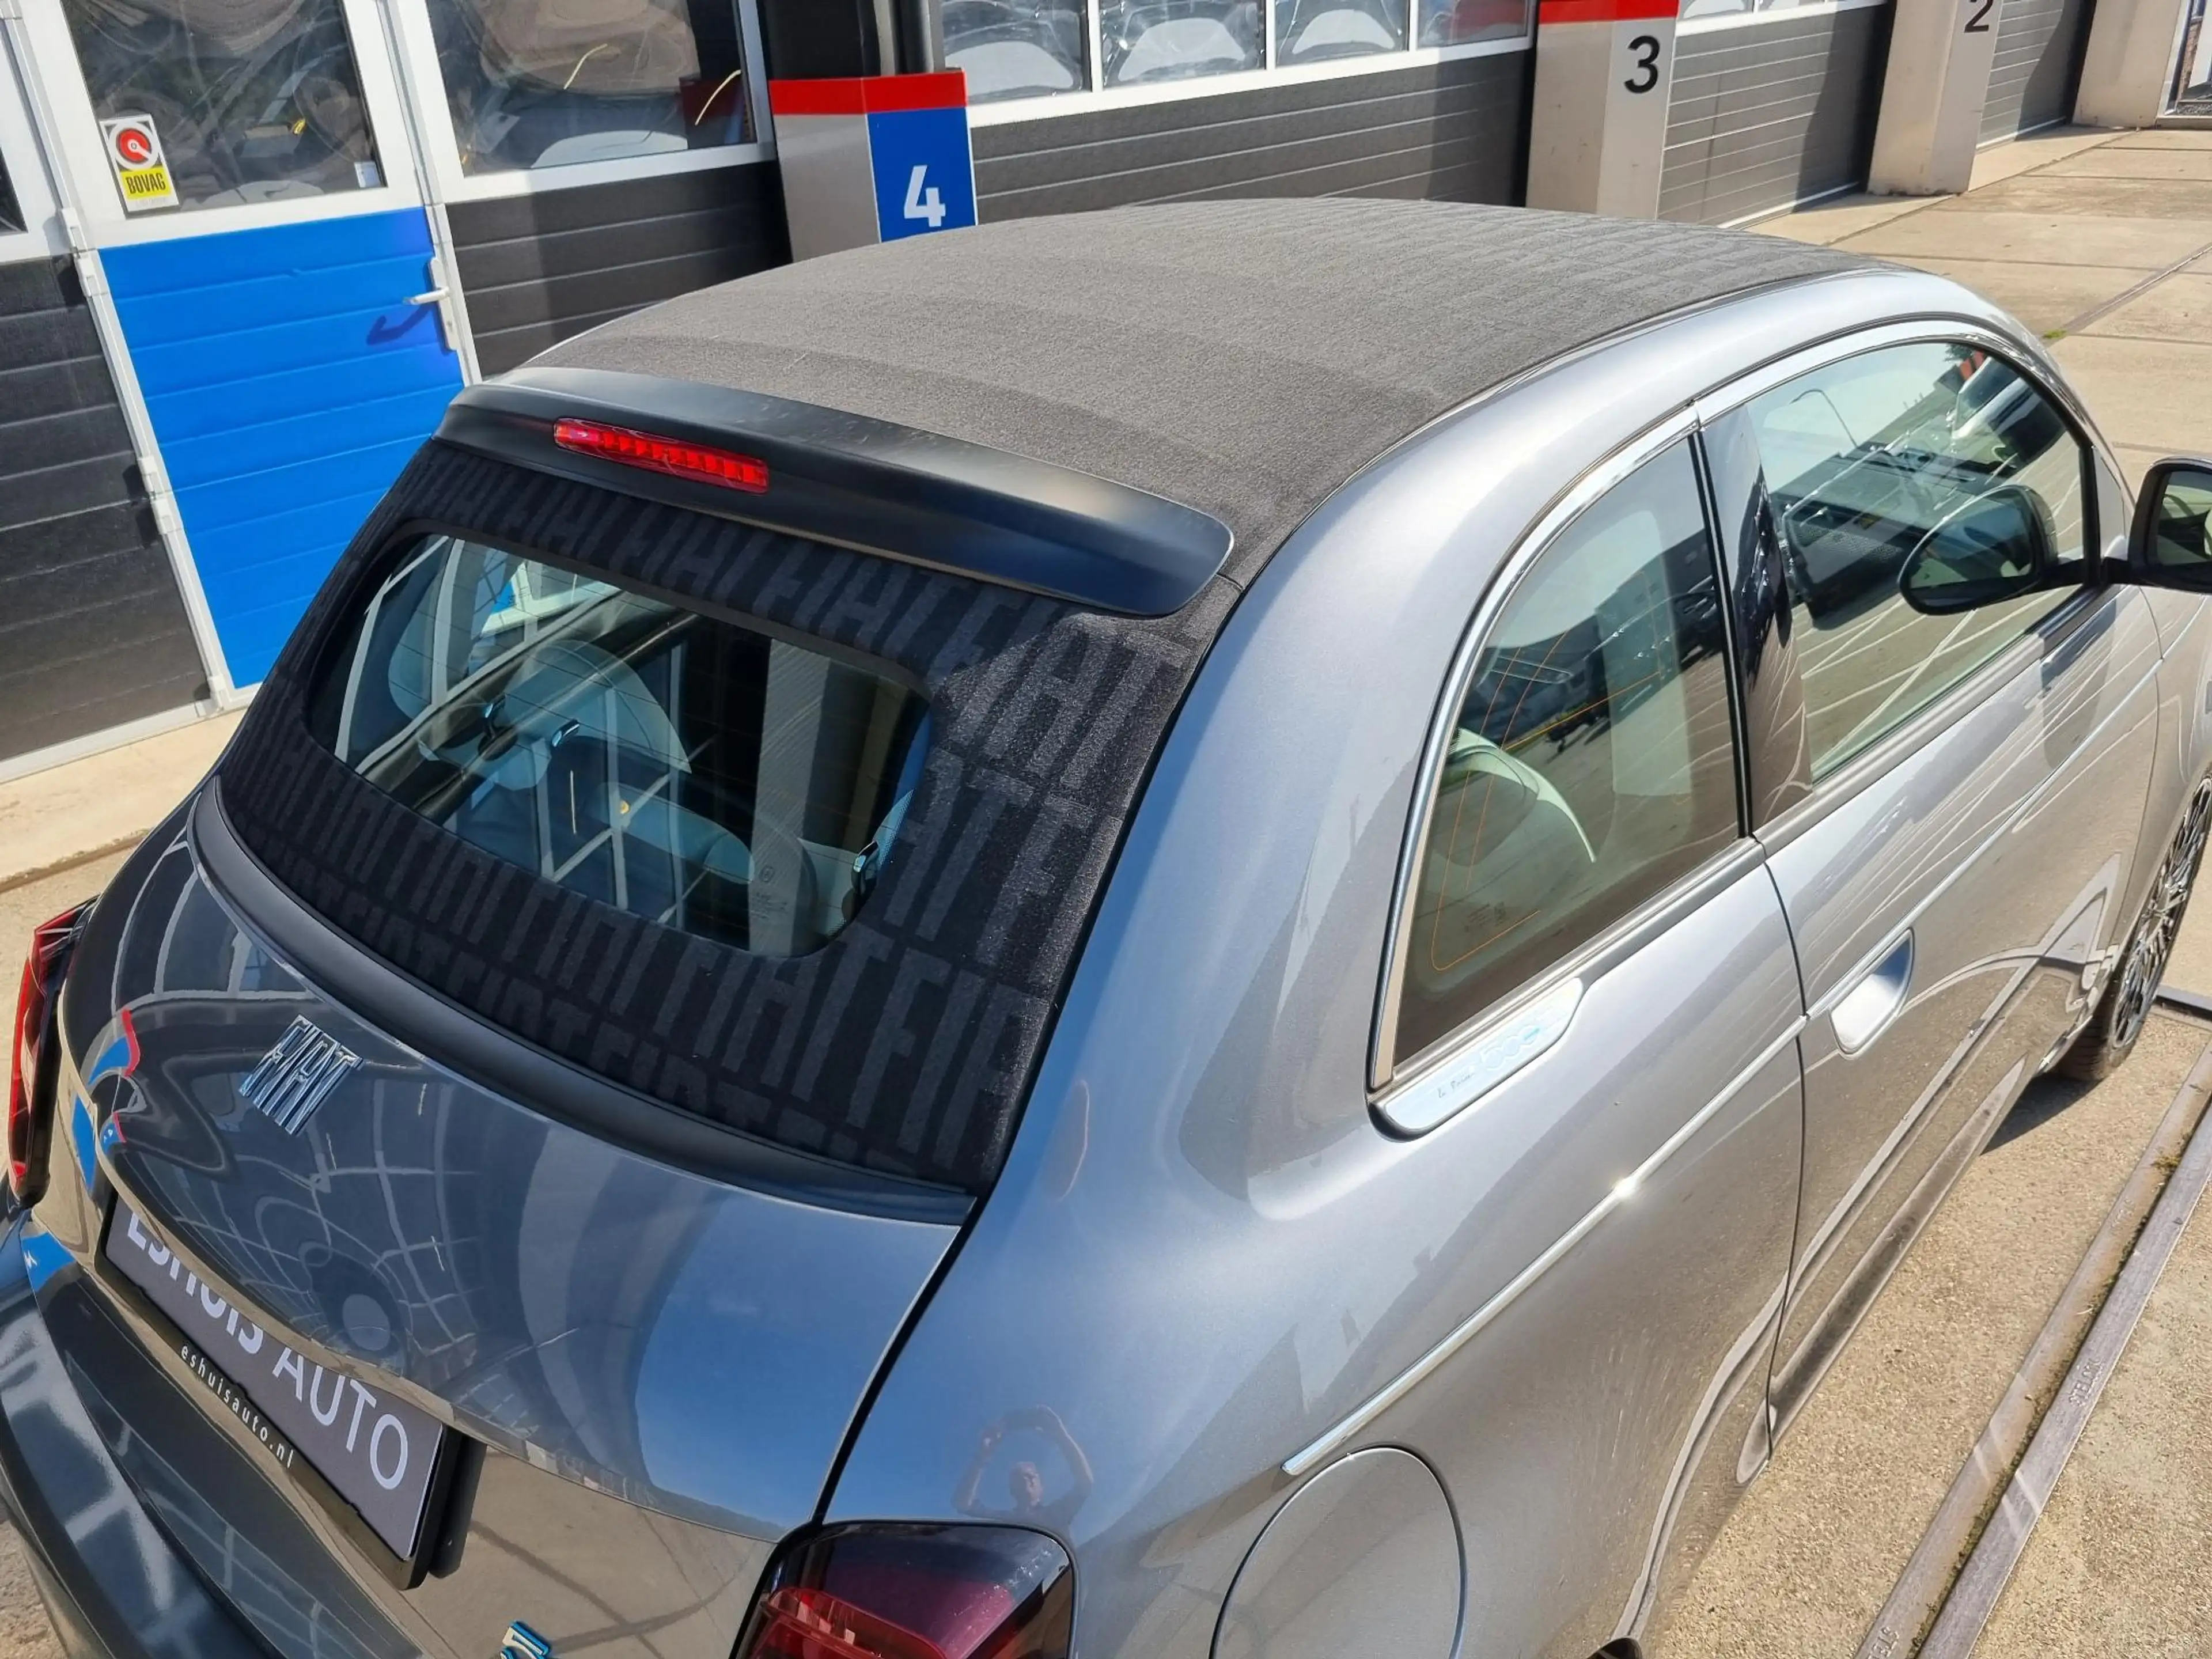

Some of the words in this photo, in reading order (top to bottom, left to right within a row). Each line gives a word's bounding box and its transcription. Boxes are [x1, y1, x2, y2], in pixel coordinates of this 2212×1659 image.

[1964, 0, 1993, 33] 2
[1624, 35, 1660, 94] 3
[125, 172, 166, 194] BOVAG
[904, 165, 946, 227] 4
[238, 1014, 364, 1135] FIAT
[181, 1344, 295, 1469] eshuisauto.nl
[272, 1347, 409, 1490] AUTO
